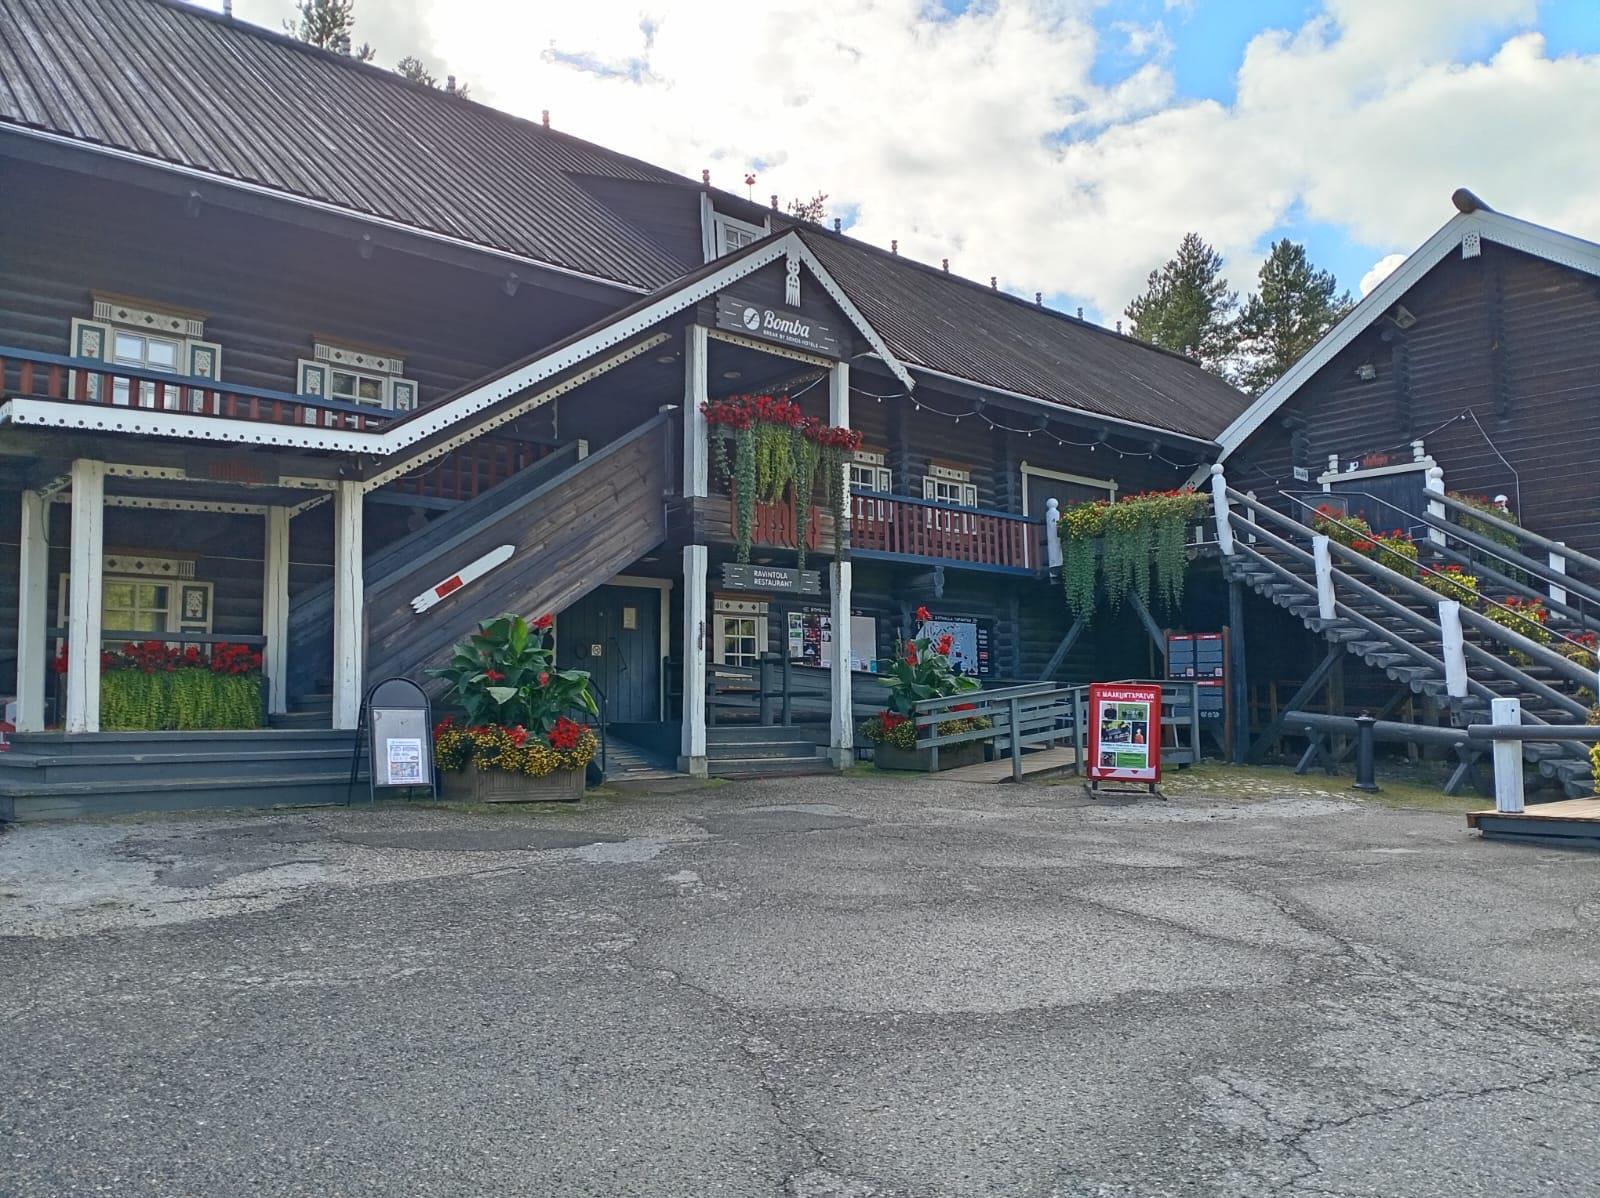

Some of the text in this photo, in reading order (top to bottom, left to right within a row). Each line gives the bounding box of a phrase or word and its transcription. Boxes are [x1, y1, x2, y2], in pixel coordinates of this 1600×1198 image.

[764, 310, 810, 338] Bomba
[753, 570, 788, 579] RAVINTOLA
[753, 578, 793, 588] RESTAURANT
